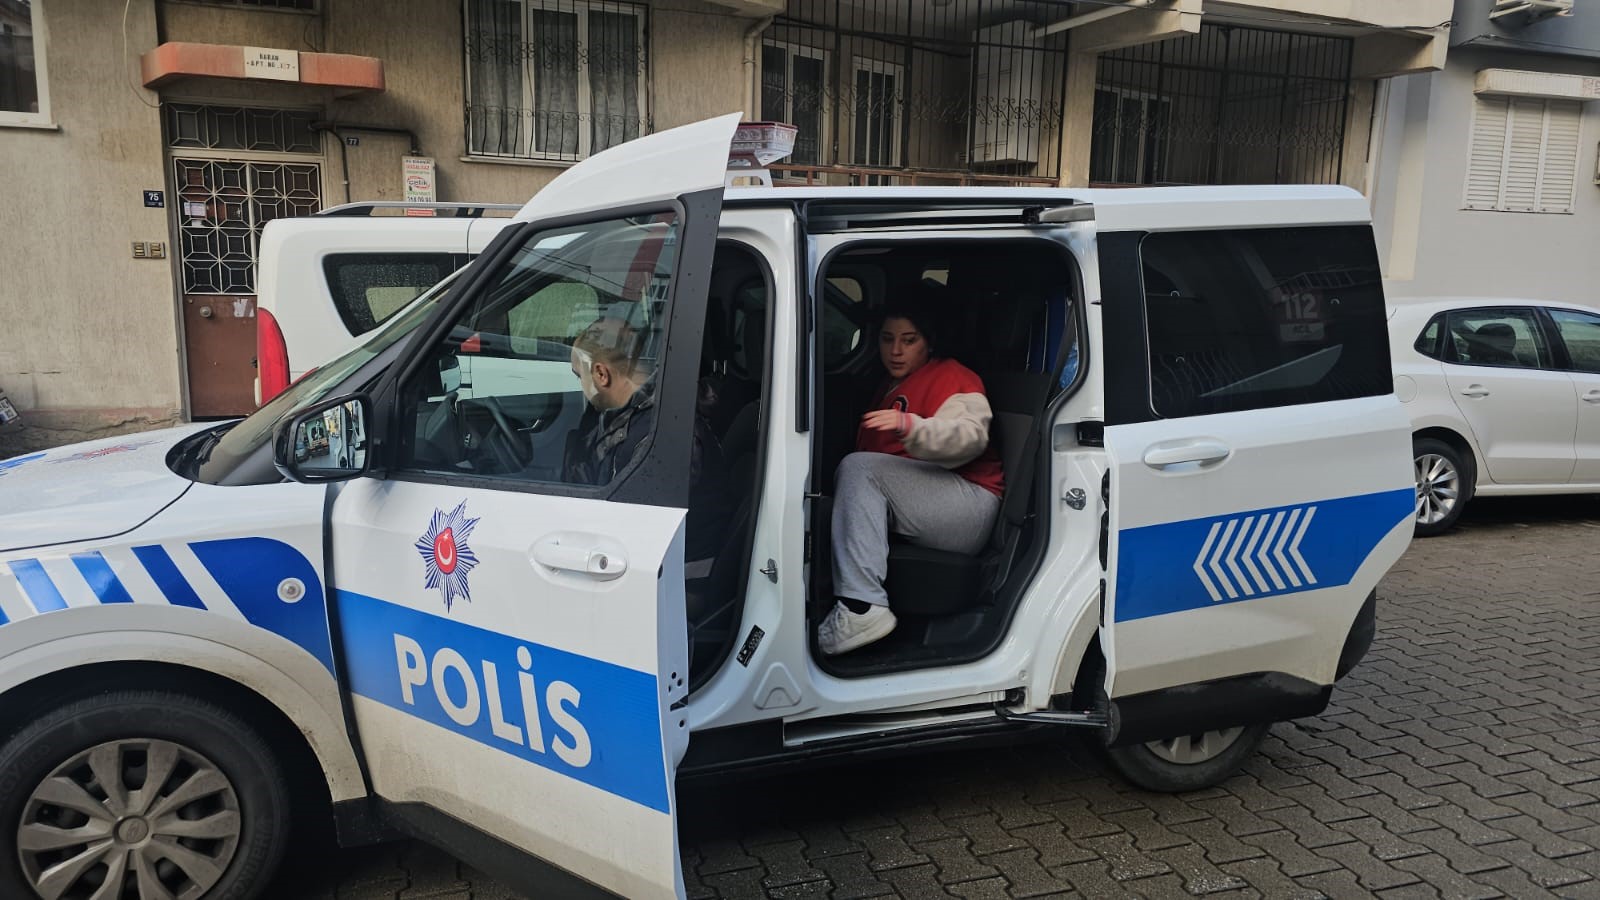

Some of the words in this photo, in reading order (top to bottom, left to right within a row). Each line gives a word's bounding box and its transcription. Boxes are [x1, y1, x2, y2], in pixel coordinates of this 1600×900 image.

[148, 192, 159, 201] 75
[1281, 293, 1318, 320] 112
[393, 633, 592, 768] POLİS
